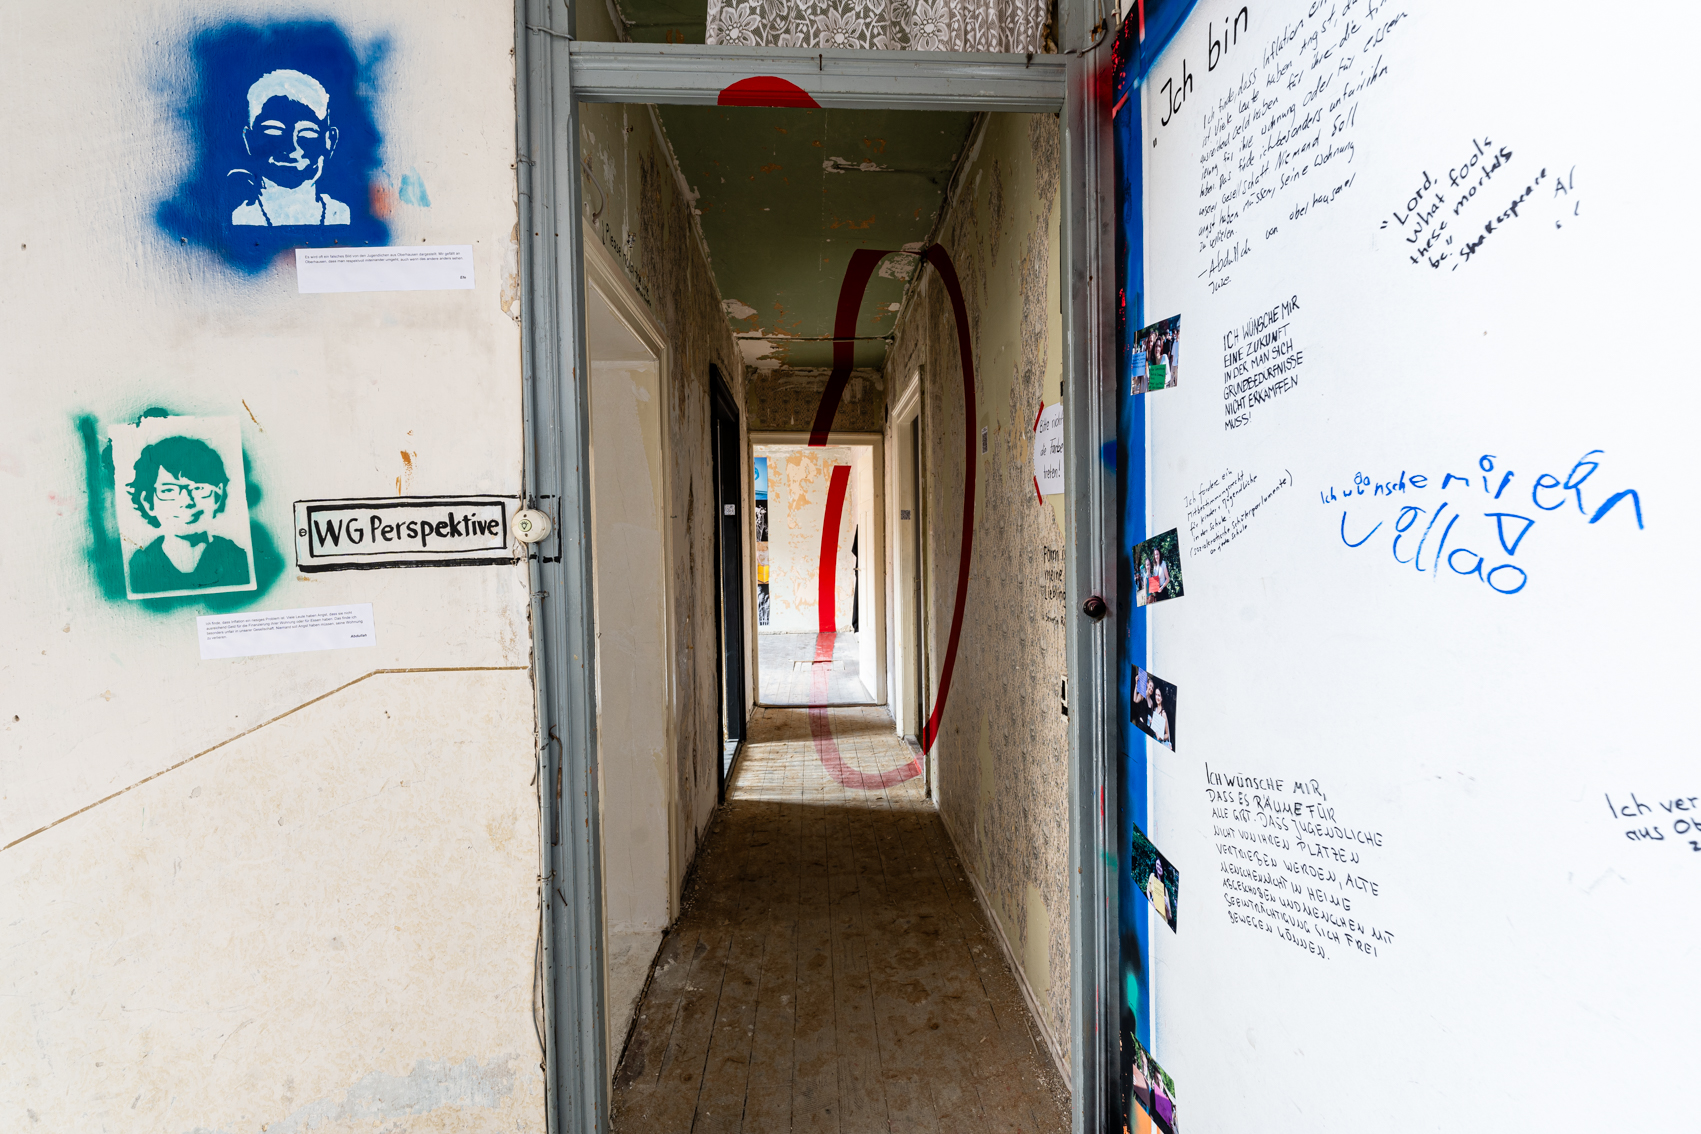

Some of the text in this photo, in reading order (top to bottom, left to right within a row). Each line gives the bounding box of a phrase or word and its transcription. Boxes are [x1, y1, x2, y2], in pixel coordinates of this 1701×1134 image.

[1208, 6, 1248, 72] bin
[1448, 136, 1492, 188] fools
[1409, 145, 1514, 265] these mortals
[1223, 330, 1239, 351] ICH
[1241, 305, 1280, 341] WÜNSCHE
[1223, 322, 1290, 368] EINE ZUKUNFT
[1224, 338, 1294, 384] IN DER MAN SICH
[1224, 396, 1246, 416] NICHT
[1224, 411, 1252, 431] MUSS!
[1320, 486, 1337, 505] Ich
[313, 512, 500, 548] WG Perspektive
[1205, 788, 1337, 824] DASS ES RÄUME FÜR
[1604, 792, 1652, 819] Ich
[1213, 825, 1235, 839] NICHT
[1297, 841, 1360, 864] PLÄTZEN
[1290, 819, 1383, 847] JUGENDLICHE
[1625, 826, 1665, 841] aus
[1290, 882, 1302, 895] IN
[1306, 886, 1351, 911] HEIME
[1346, 873, 1379, 896] ALTE
[1314, 923, 1340, 944] SICH
[1344, 933, 1378, 957] FREI
[1371, 926, 1395, 944] MIT
